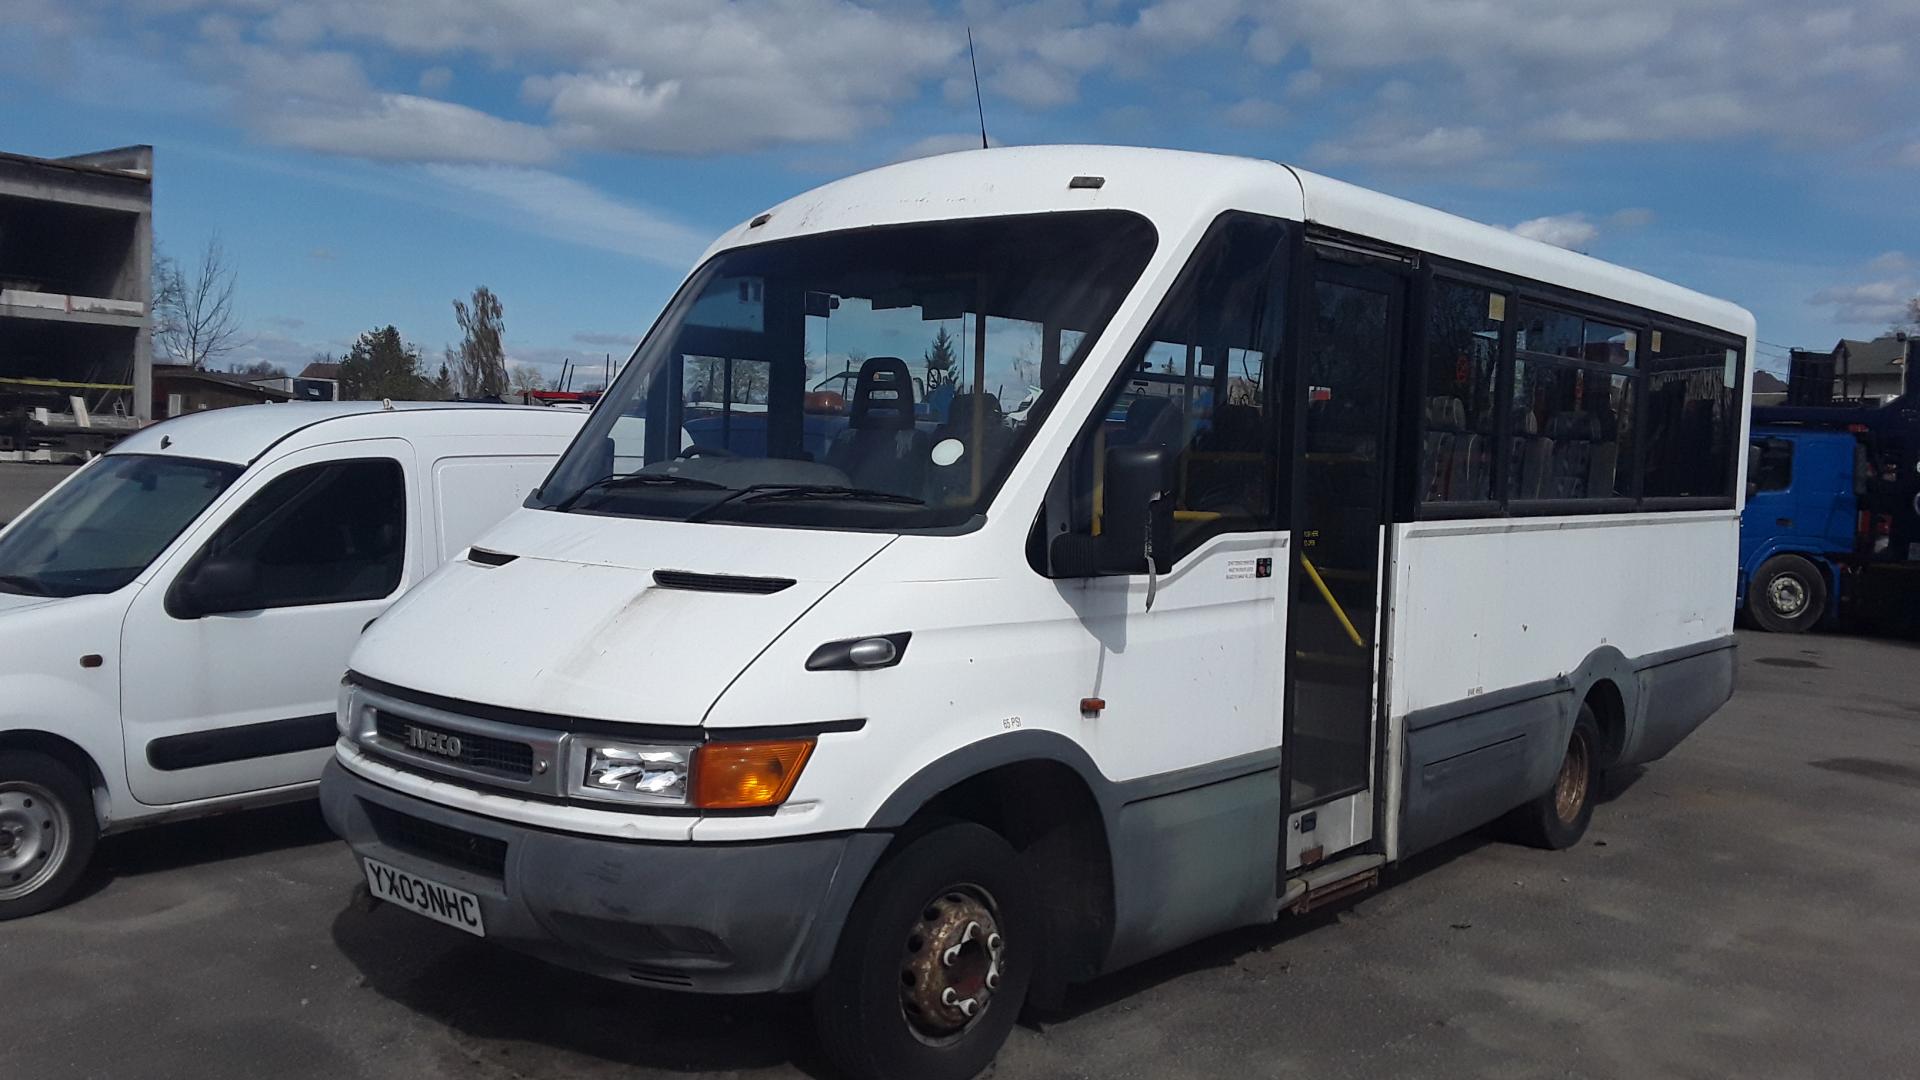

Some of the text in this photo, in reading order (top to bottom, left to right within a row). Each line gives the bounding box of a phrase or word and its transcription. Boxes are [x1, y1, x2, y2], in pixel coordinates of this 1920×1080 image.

[1002, 716, 1022, 729] 65 PSI
[408, 727, 461, 757] IVECO
[369, 862, 478, 927] YX03NHC
